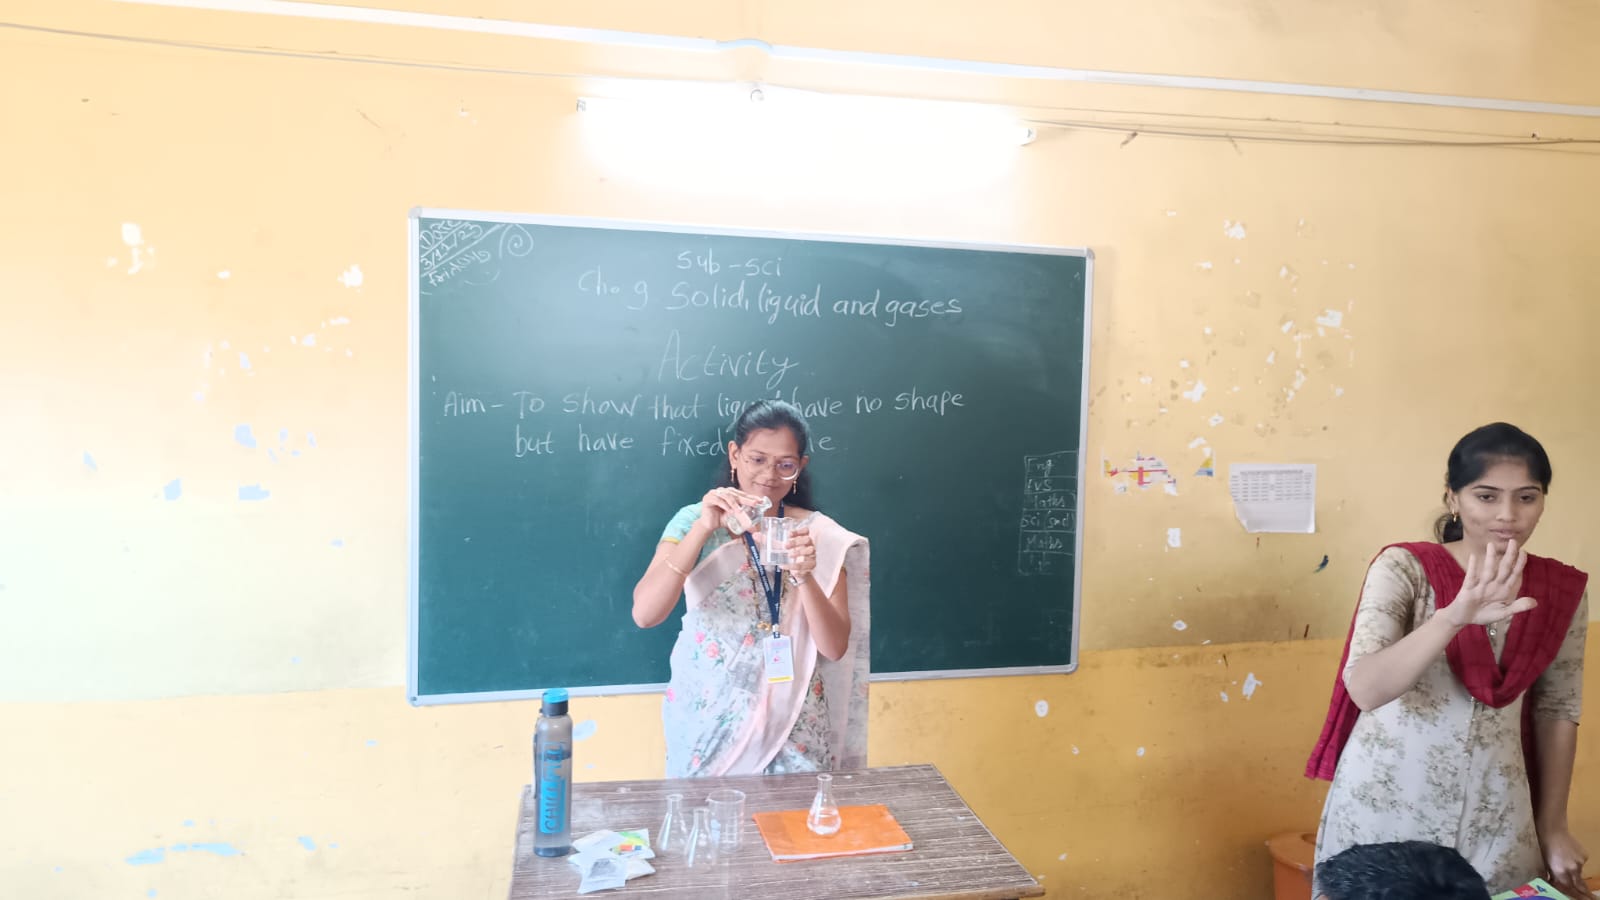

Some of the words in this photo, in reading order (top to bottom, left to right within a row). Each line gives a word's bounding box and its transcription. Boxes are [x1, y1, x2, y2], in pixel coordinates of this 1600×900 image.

[832, 288, 878, 318] and
[885, 297, 963, 327] gases
[657, 328, 799, 390] Activity
[513, 390, 545, 419] To
[562, 386, 643, 417] show
[648, 393, 704, 419] that
[791, 386, 843, 418] have
[855, 393, 883, 414] no
[894, 385, 965, 416] shape
[515, 424, 555, 458] but
[578, 423, 634, 452] have
[657, 425, 726, 456] fixed
